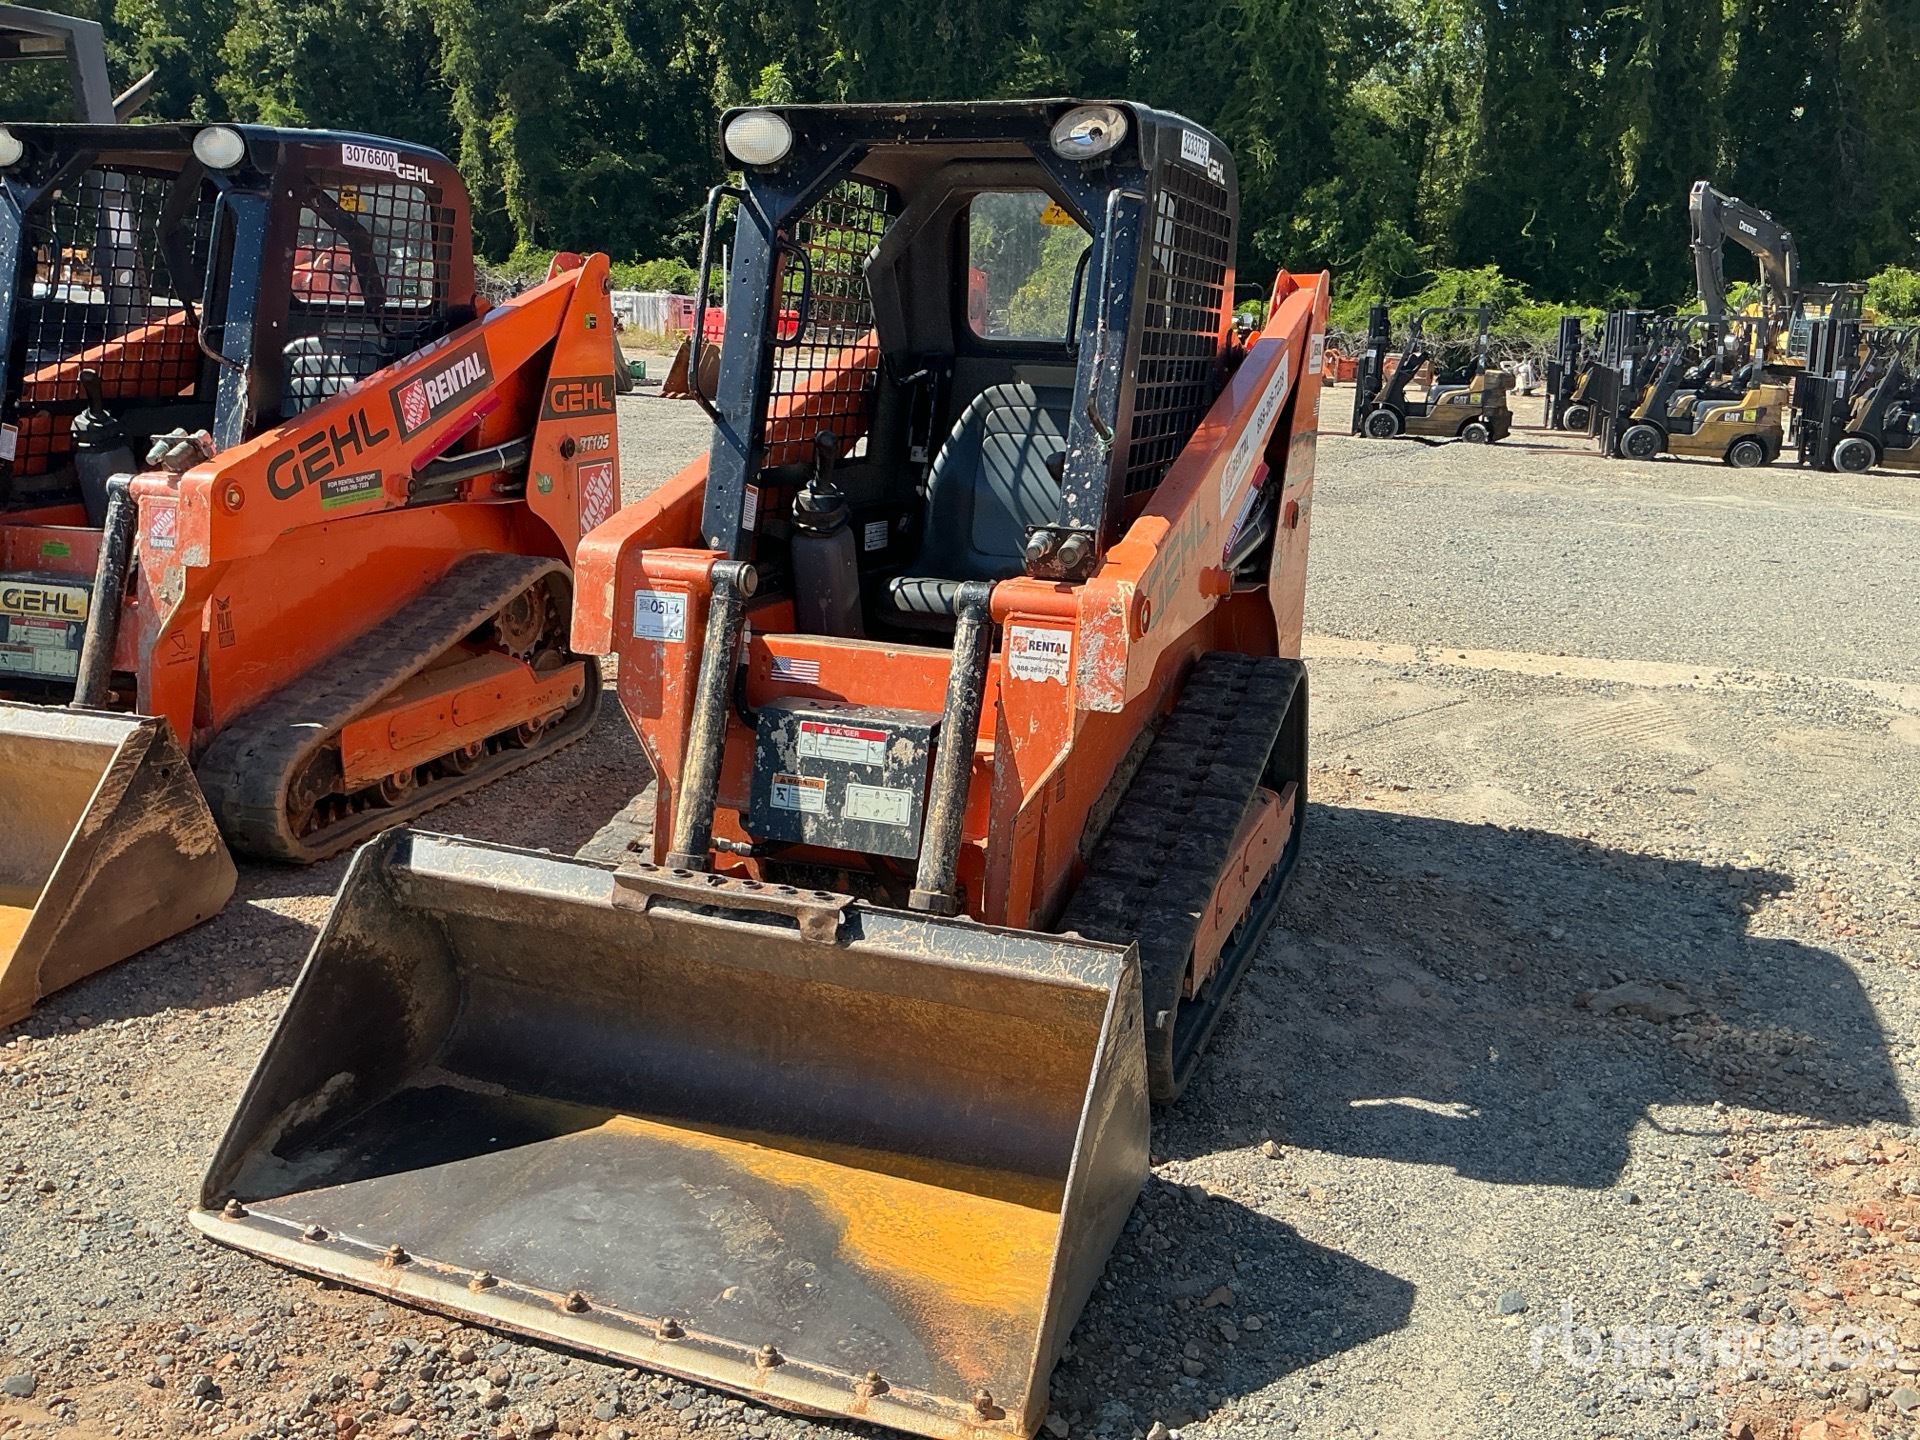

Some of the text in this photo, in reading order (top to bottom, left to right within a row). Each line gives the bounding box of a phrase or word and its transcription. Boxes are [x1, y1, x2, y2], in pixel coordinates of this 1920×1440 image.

[346, 146, 395, 168] 3076600
[395, 162, 434, 185] GEHL
[1207, 157, 1225, 185] GEHL
[1738, 219, 1758, 237] DEERE
[424, 351, 487, 410] RENTAL
[550, 383, 612, 413] GEHL
[1453, 395, 1469, 405] CAT
[1724, 412, 1741, 422] CAT
[266, 407, 390, 501] GEHL
[327, 472, 376, 489] FOR RENTAL SUPPORT
[583, 472, 597, 500] THE
[581, 464, 611, 533] HOME
[151, 537, 174, 548] RENTAL
[2, 588, 79, 615] GEHL
[1028, 640, 1068, 654] RENTAL
[830, 728, 860, 738] DANGER
[787, 779, 820, 788] WARNING
